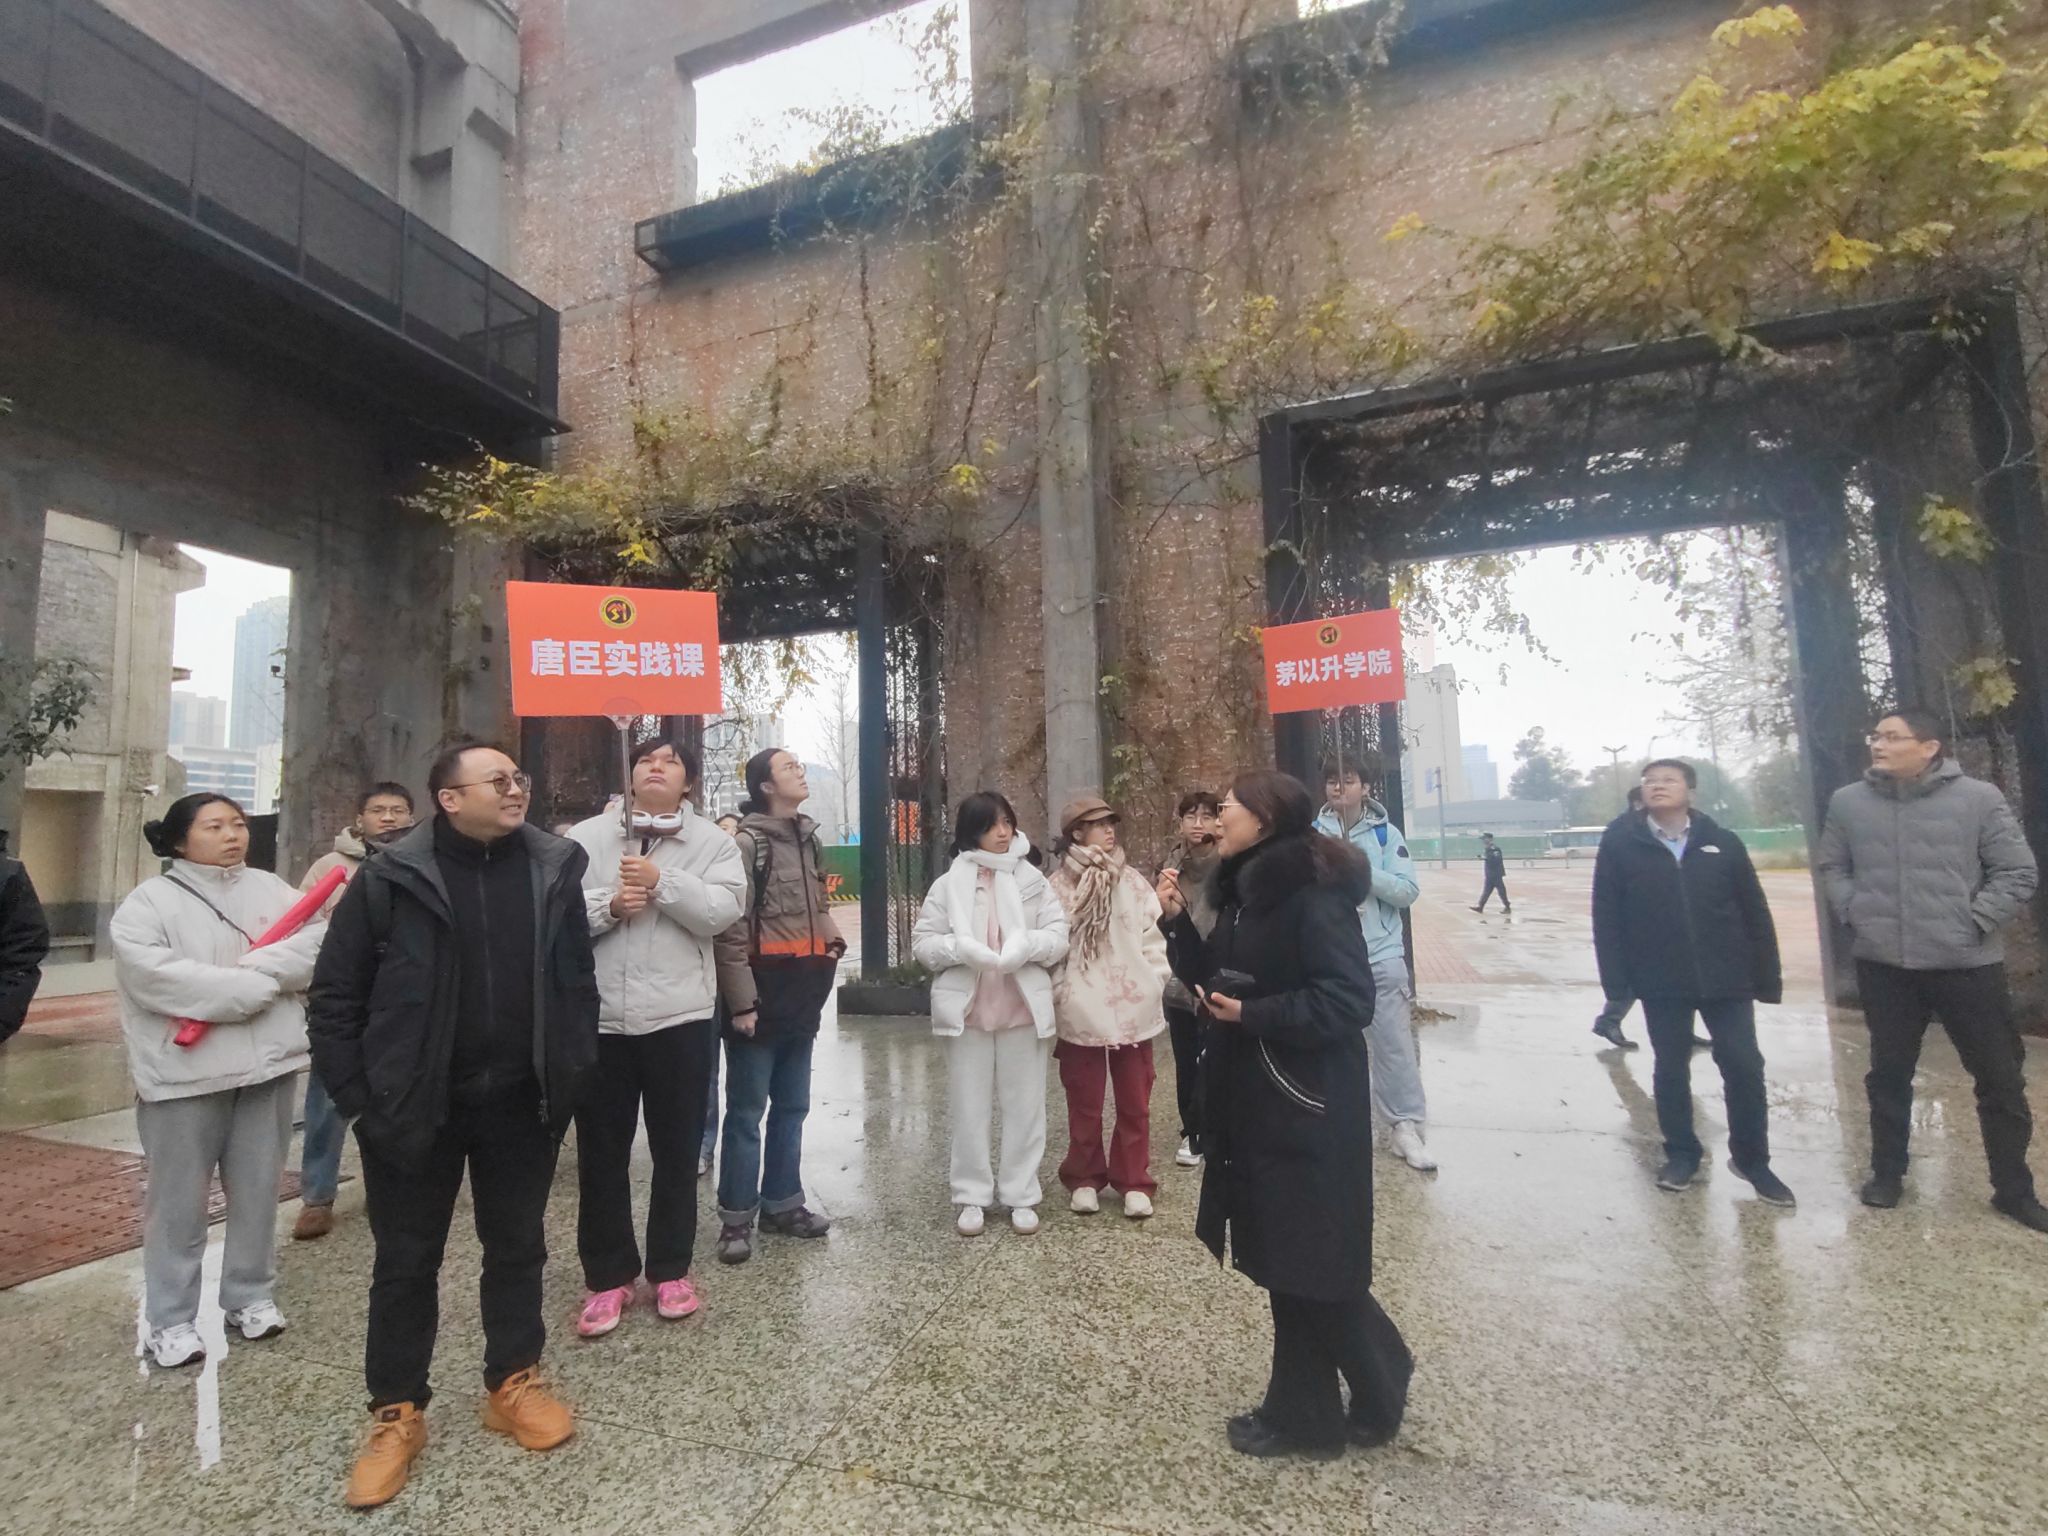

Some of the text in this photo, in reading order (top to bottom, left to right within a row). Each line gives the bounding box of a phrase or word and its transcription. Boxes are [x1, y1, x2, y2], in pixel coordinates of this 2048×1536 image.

[531, 638, 705, 678] 唐臣实践课
[1275, 648, 1392, 687] 茅以升学院
